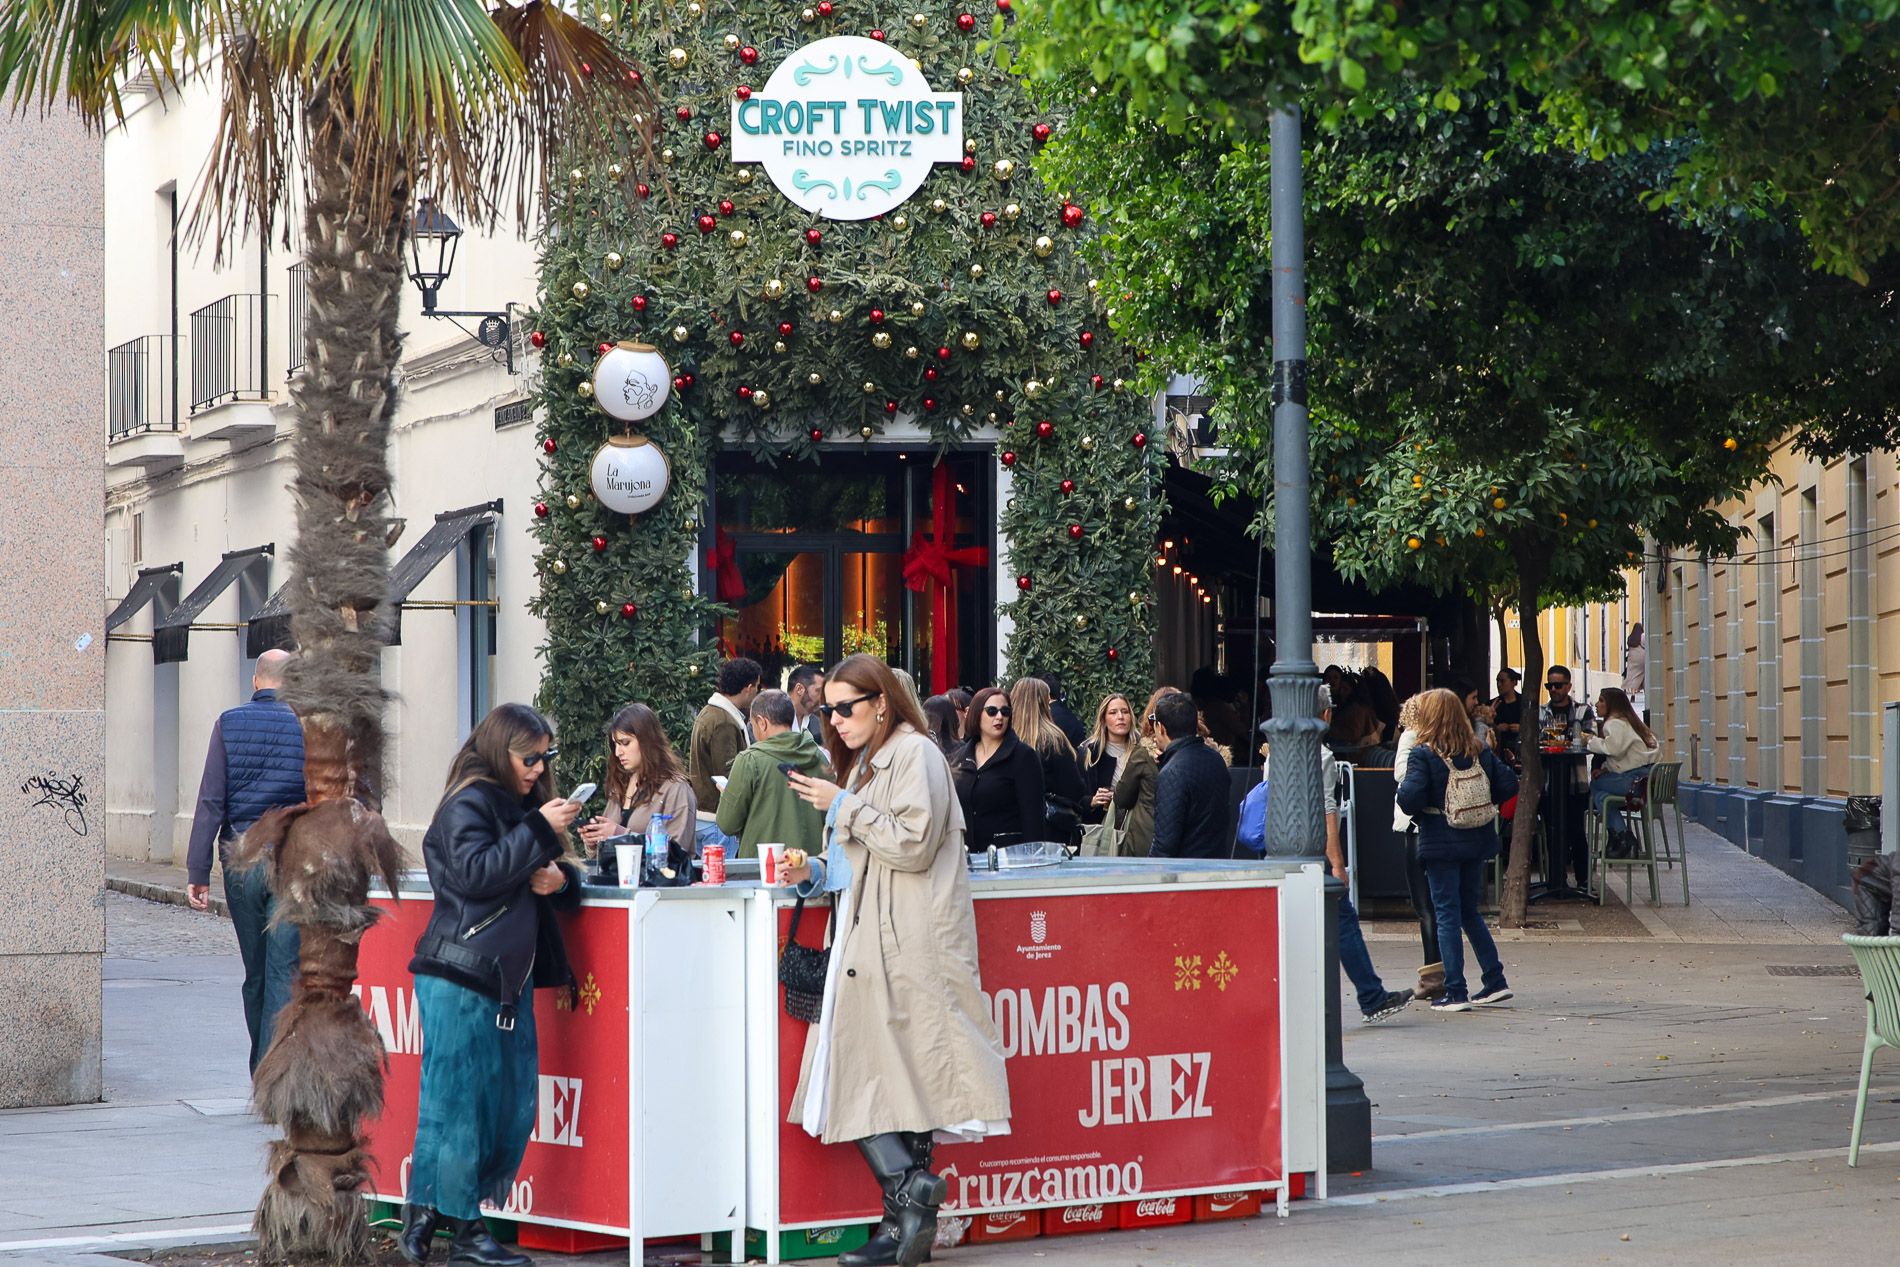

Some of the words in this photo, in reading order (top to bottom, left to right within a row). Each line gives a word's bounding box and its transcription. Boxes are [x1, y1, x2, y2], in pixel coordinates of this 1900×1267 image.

[738, 98, 847, 135] CROFT
[858, 98, 956, 135] TWIST
[783, 140, 833, 156] FINO
[841, 140, 912, 156] SPRITZ
[607, 463, 619, 477] La
[606, 477, 651, 493] Marujona
[1016, 944, 1062, 954] Ayuntamiento
[1078, 1052, 1213, 1128] JEREZ
[979, 1159, 1009, 1168] Cruzcampo
